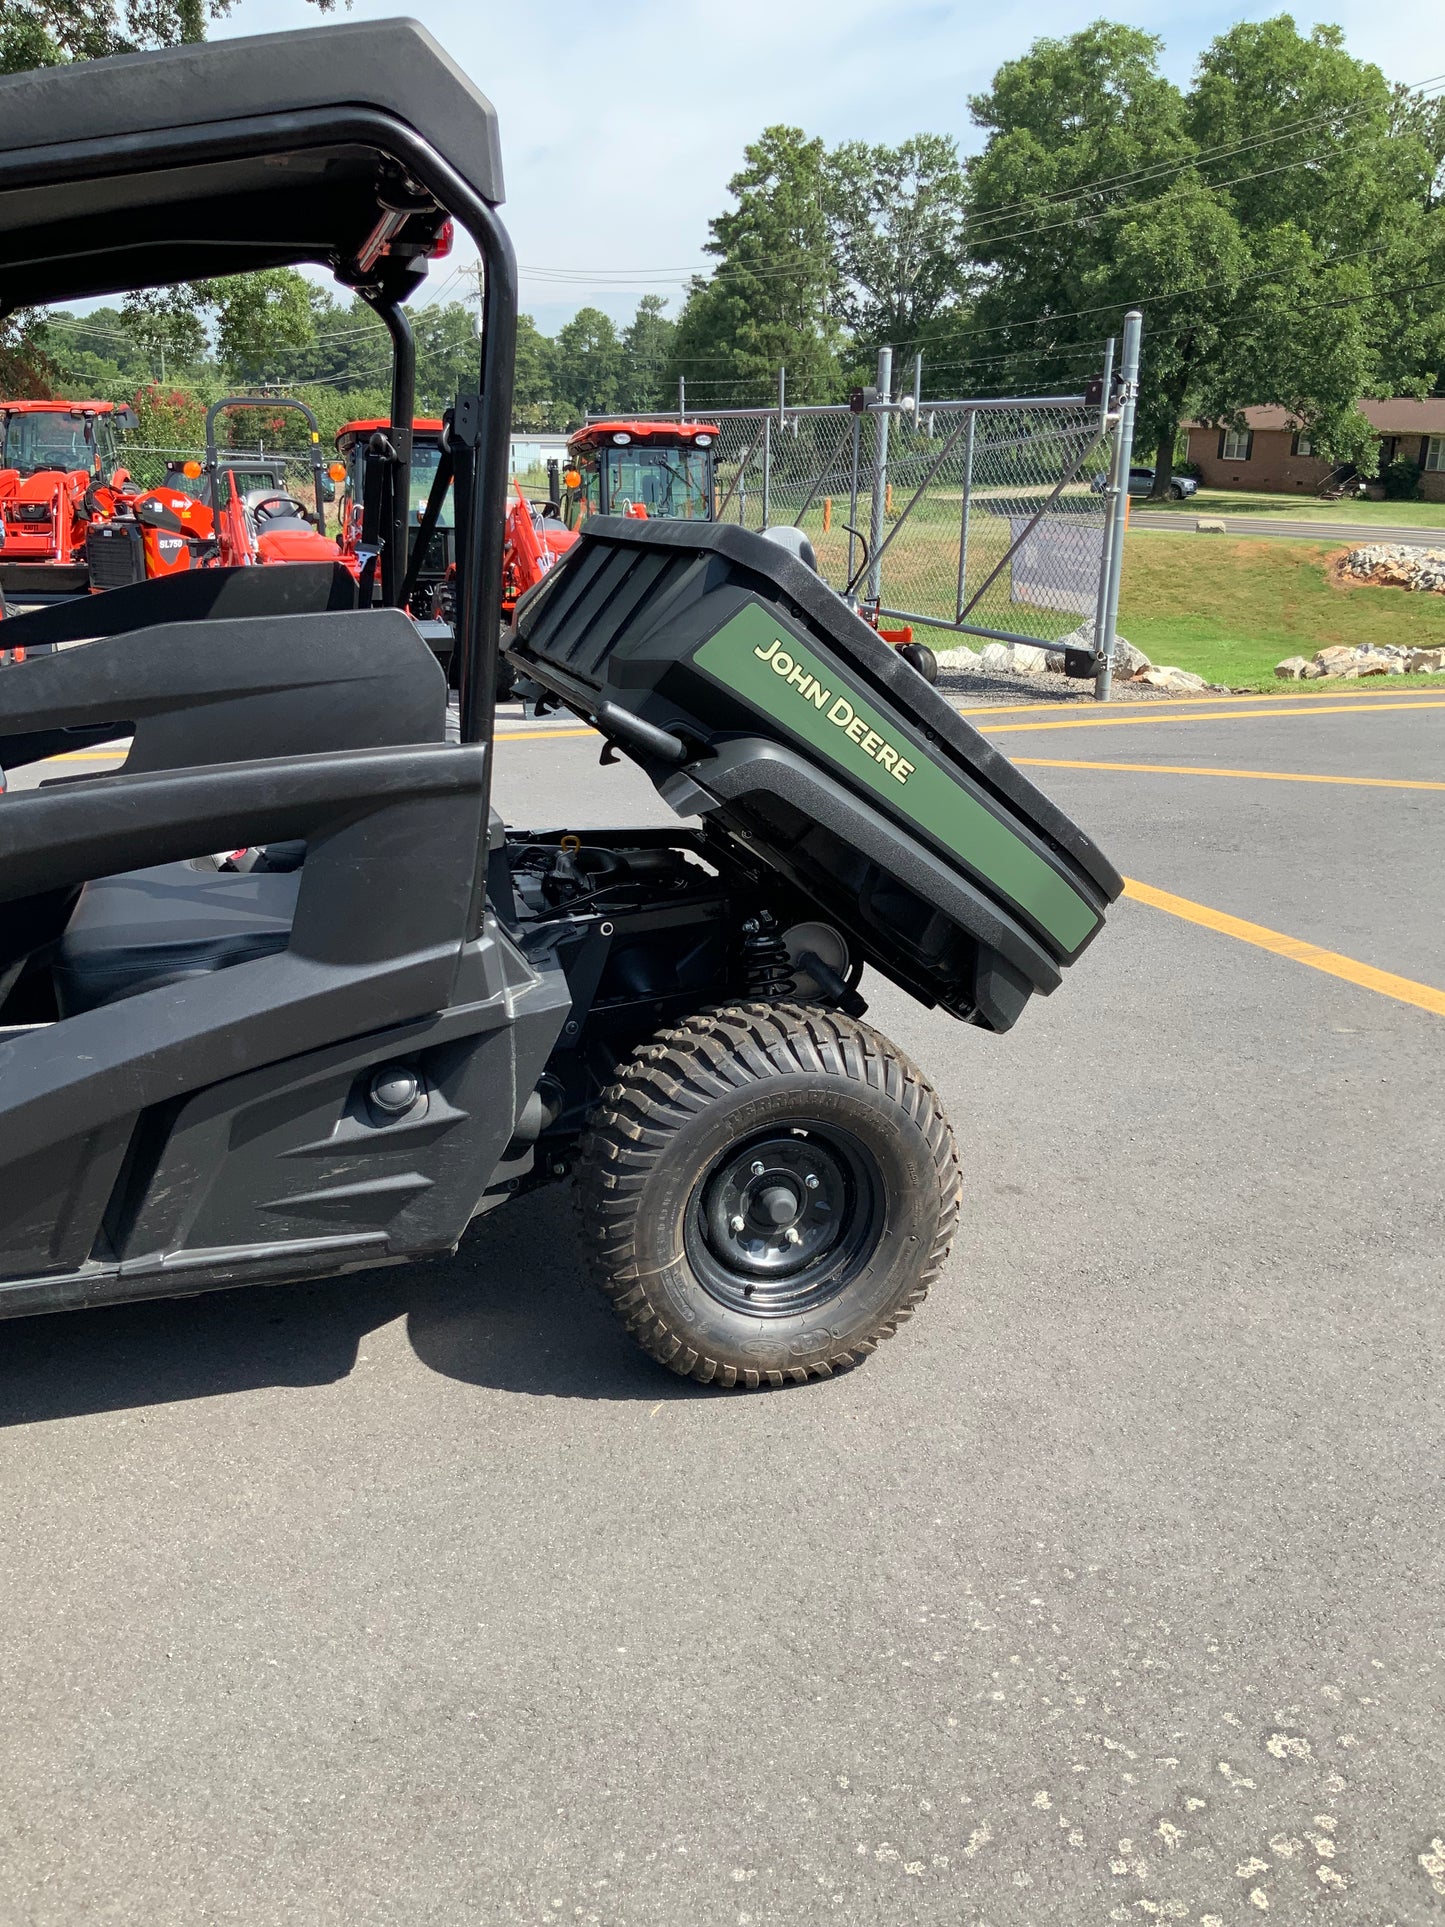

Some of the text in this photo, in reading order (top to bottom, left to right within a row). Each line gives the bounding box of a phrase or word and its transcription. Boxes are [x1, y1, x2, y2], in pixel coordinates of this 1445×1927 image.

[159, 539, 183, 549] SL750
[753, 638, 917, 785] JOHN DEERE
